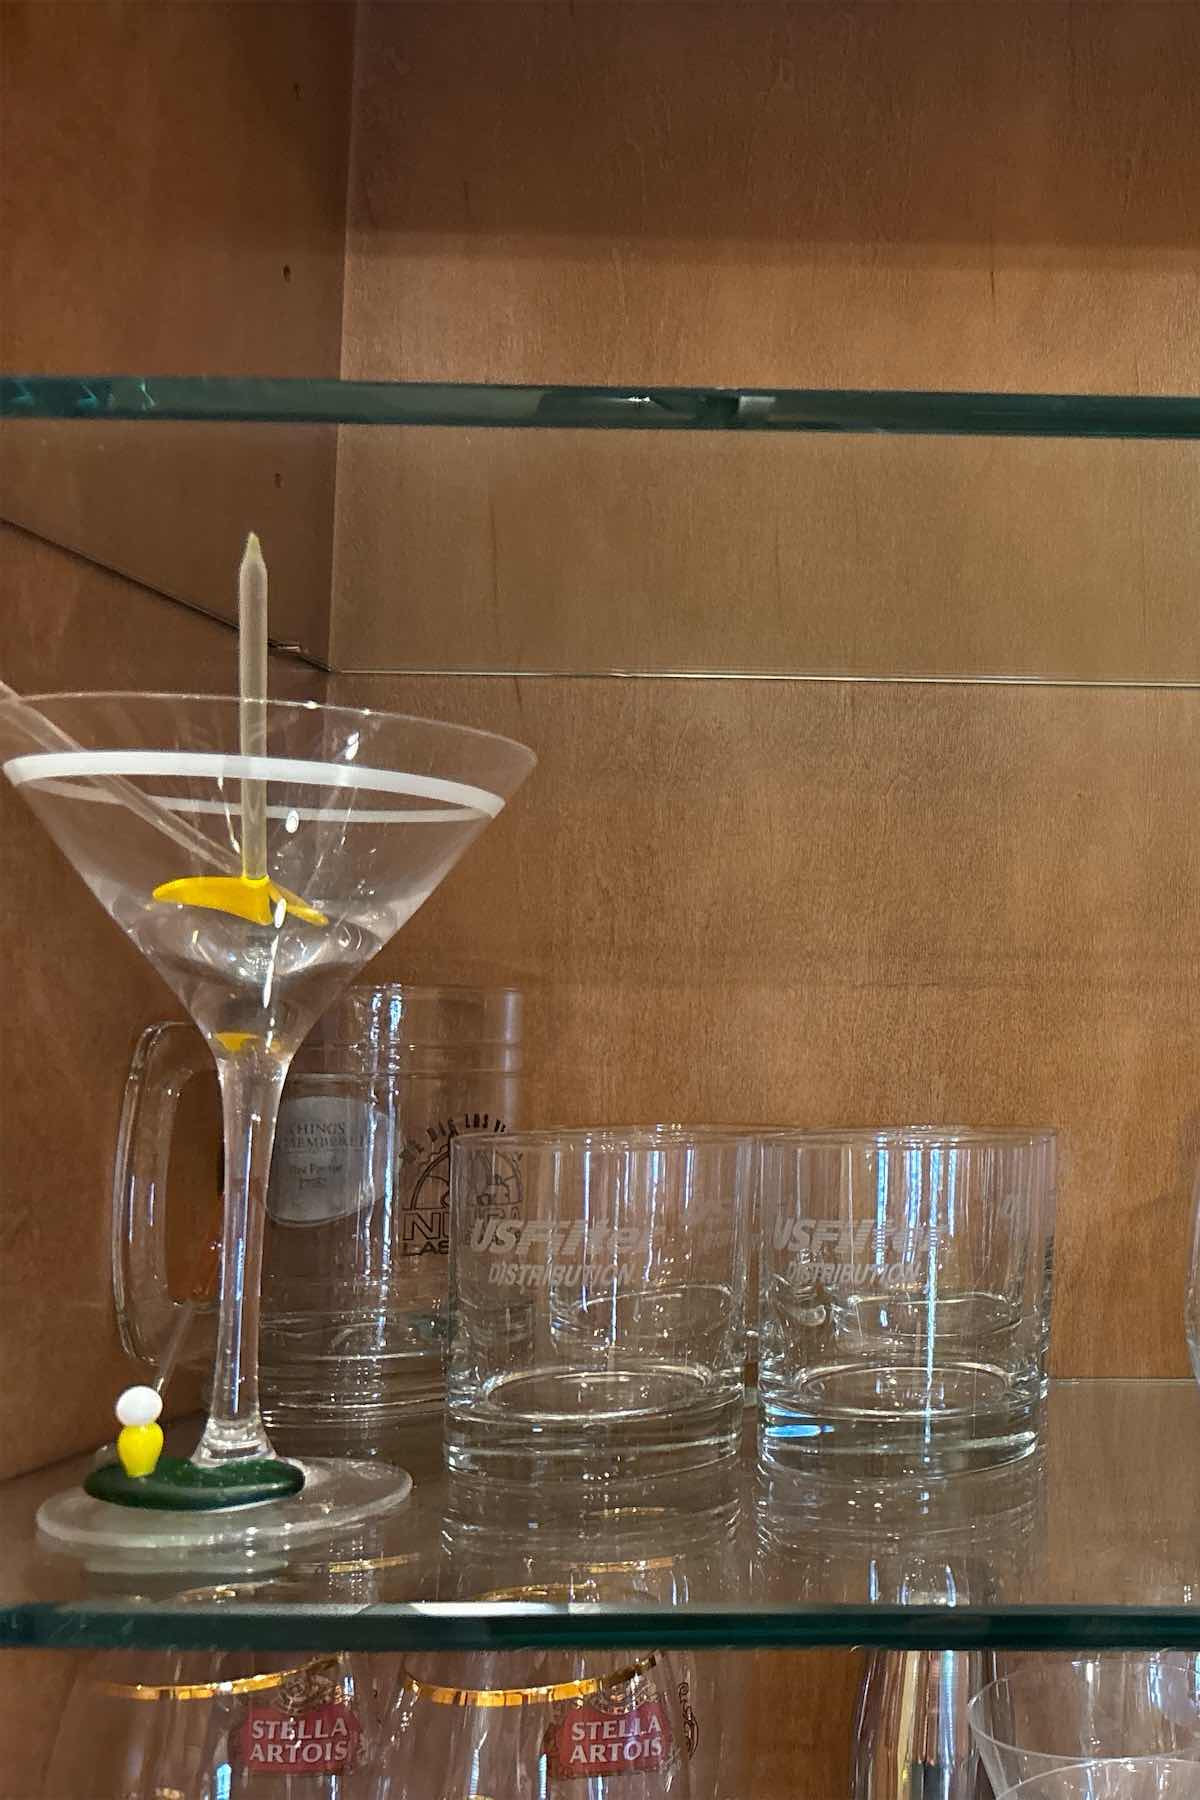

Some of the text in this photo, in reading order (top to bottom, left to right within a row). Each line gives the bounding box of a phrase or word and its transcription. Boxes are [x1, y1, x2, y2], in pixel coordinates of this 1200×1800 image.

[251, 1717, 349, 1741] STELLA
[571, 1714, 662, 1740] STELLA
[248, 1741, 349, 1765] ARTOIS
[569, 1737, 663, 1765] ARTOIS
